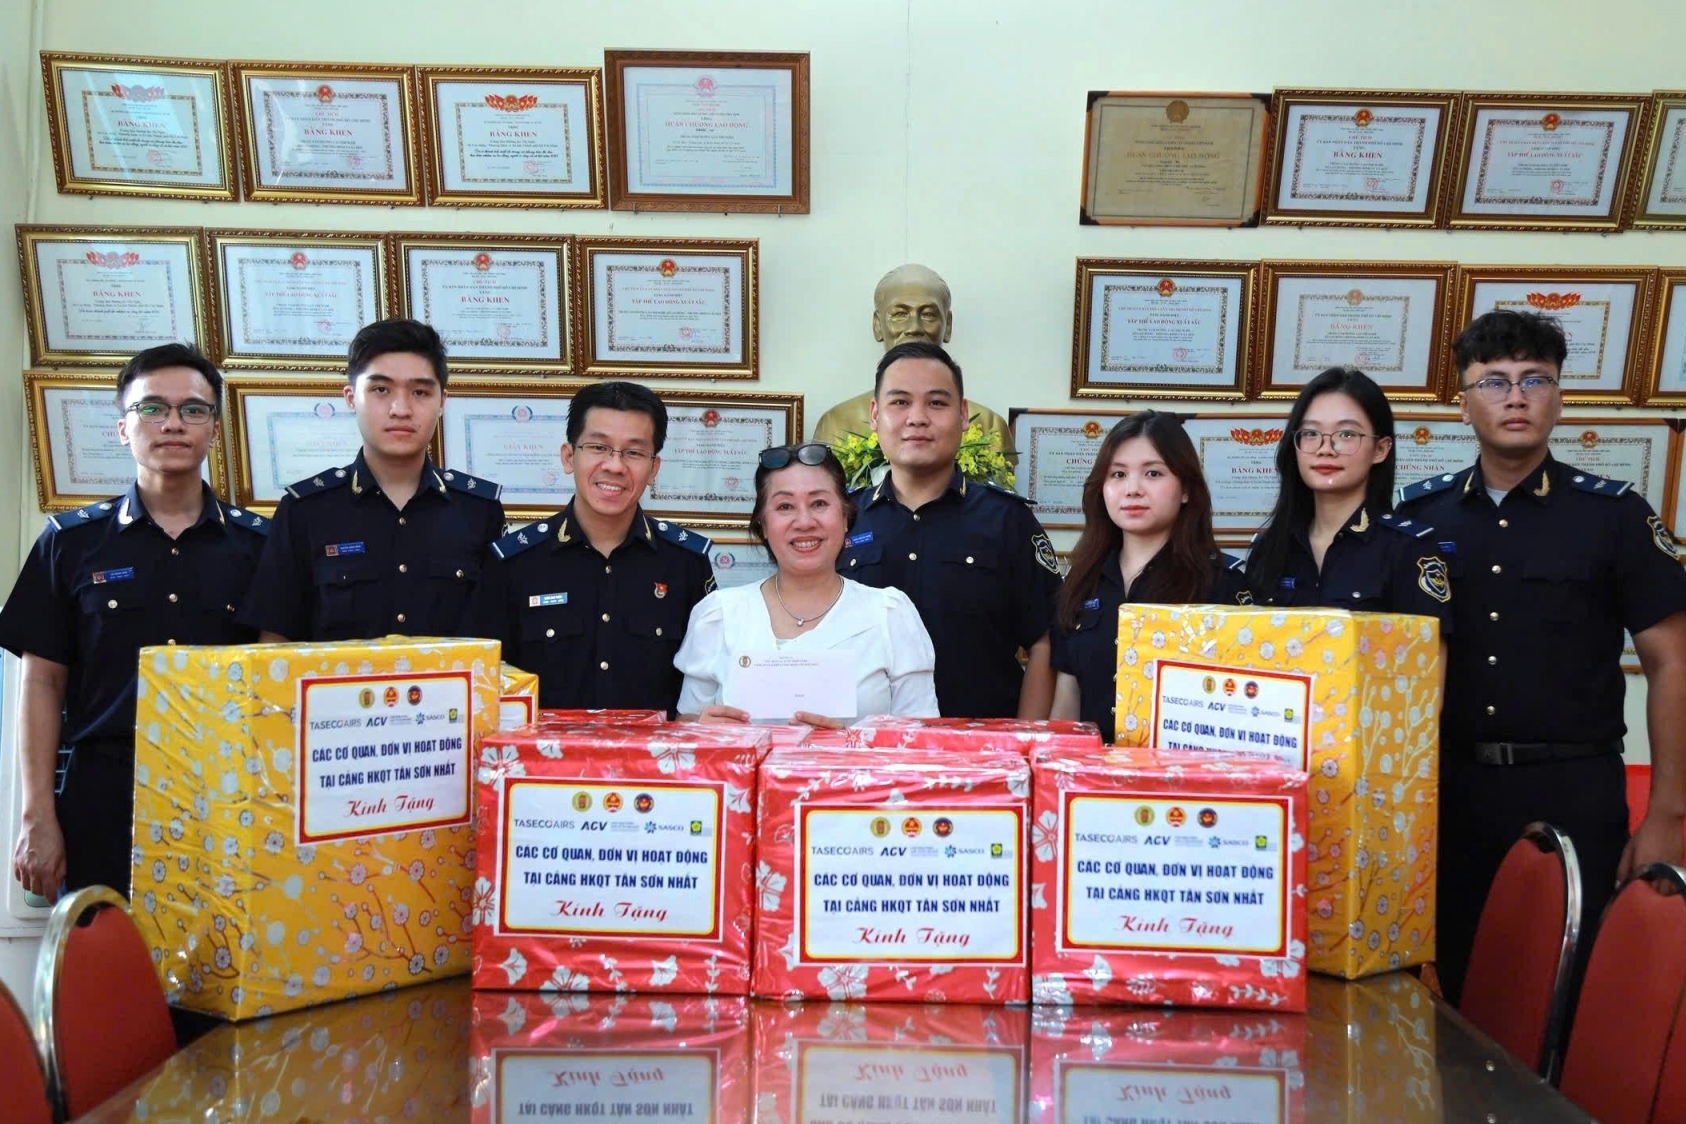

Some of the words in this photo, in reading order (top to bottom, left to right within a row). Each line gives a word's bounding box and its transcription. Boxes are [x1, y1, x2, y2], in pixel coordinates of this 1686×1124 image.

[1208, 702, 1226, 711] ACV
[366, 716, 388, 728] ACV
[580, 821, 608, 831] ACV
[1144, 836, 1170, 845] ACV
[516, 844, 538, 859] CÁC
[542, 846, 558, 860] CƠ
[598, 847, 622, 861] ĐƠN
[626, 849, 638, 865] VỊ
[642, 850, 672, 864] HOẠT
[676, 848, 708, 865] ĐỘNG
[880, 847, 907, 856] ACV
[1077, 859, 1101, 874] CÁC
[1105, 859, 1122, 874] CƠ
[1163, 862, 1186, 877] ĐƠN
[1190, 865, 1202, 880] VỊ
[1206, 865, 1236, 880] HOẠT
[1241, 864, 1273, 880] ĐỘNG
[524, 872, 541, 886] TẠI
[545, 870, 576, 886] CẢNG
[580, 874, 611, 888] HKQT
[615, 872, 636, 887] TÂN
[640, 874, 664, 888] SƠN
[668, 872, 698, 889] NHẤT
[814, 872, 838, 887] CÁC
[842, 872, 858, 887] CƠ
[899, 872, 923, 887] ĐƠN
[927, 874, 938, 889] VỊ
[943, 874, 973, 888] HOẠT
[977, 872, 1009, 889] ĐỘNG
[1086, 886, 1104, 902] TẠI
[1109, 885, 1140, 900] CẢNG
[1144, 888, 1175, 903] HKQT
[1180, 888, 1201, 903] TÂN
[1206, 889, 1229, 904] SƠN
[1233, 890, 1264, 905] NHẤT
[549, 900, 604, 917] Kính
[614, 902, 667, 922] Tặng
[823, 899, 841, 915] TẠI
[846, 897, 877, 913] CẢNG
[882, 899, 911, 914] HKQT
[917, 898, 938, 912] TÂN
[942, 897, 965, 913] SƠN
[969, 896, 1000, 913] NHẤT
[1114, 915, 1169, 933] Kính
[1180, 917, 1234, 938] Tặng
[853, 927, 906, 945] Kính
[916, 928, 970, 948] Tặng
